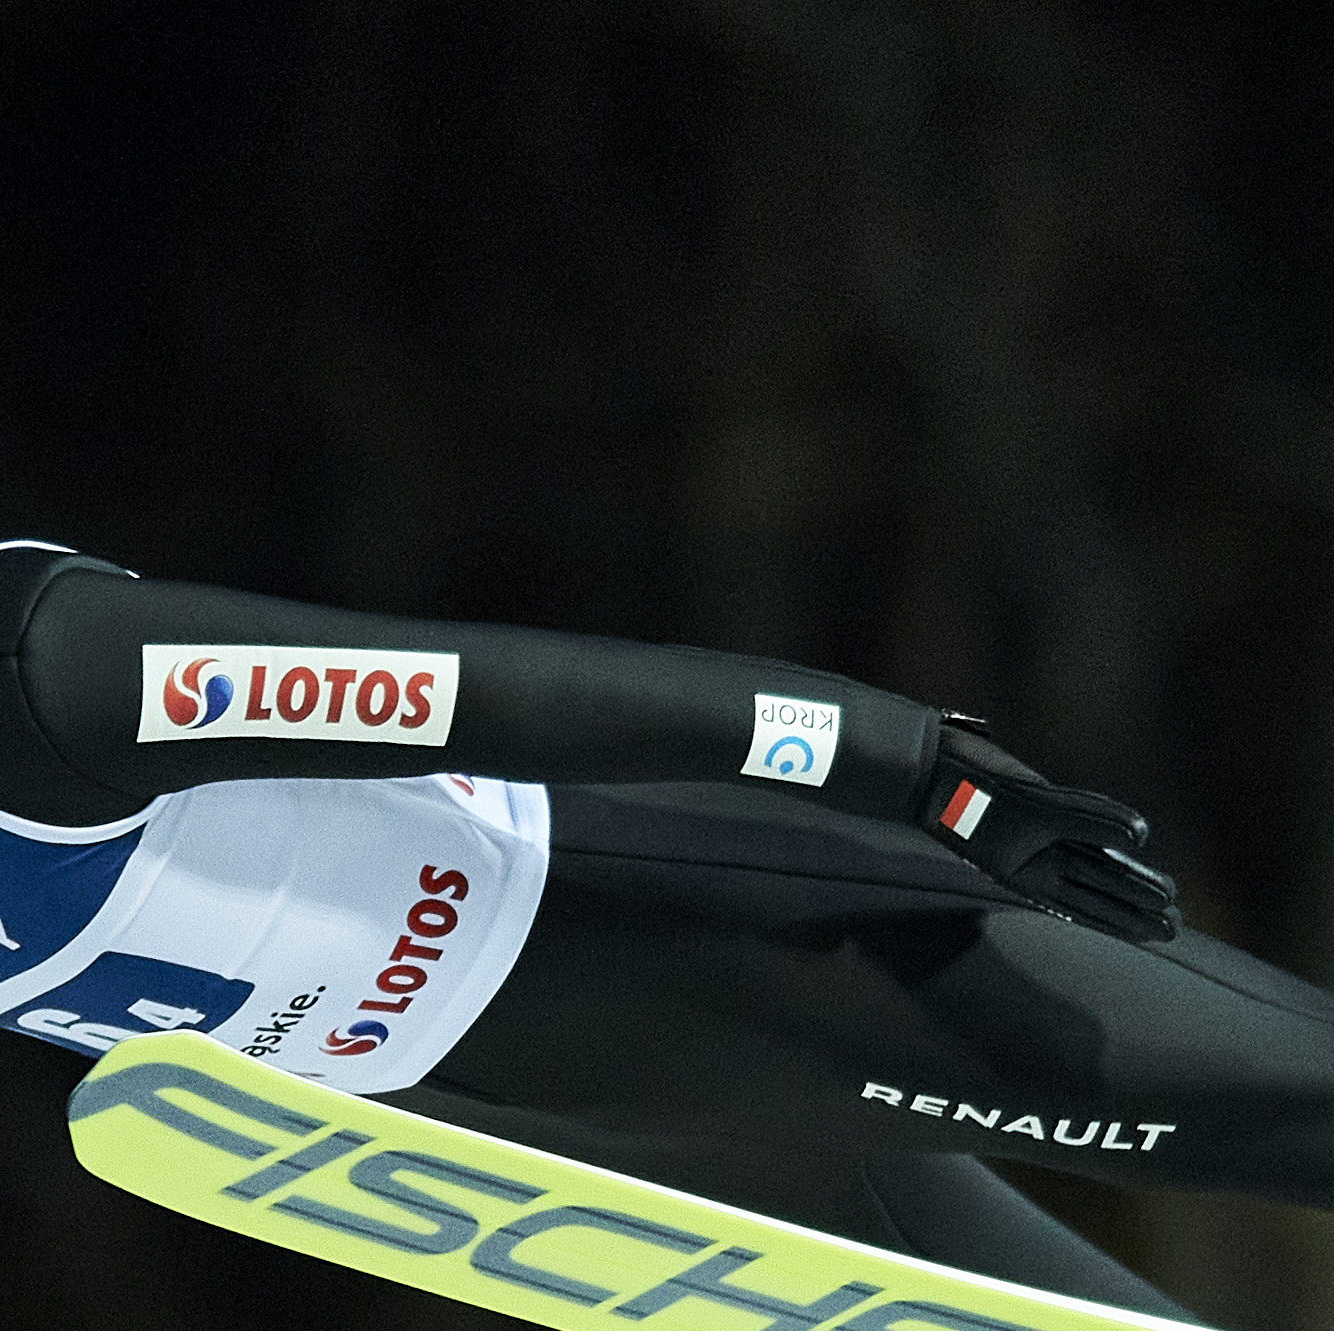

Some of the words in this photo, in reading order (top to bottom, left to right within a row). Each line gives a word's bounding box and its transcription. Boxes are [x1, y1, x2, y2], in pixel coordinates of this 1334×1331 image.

[244, 665, 435, 729] LOTOS
[356, 864, 469, 1014] LOTOS
[861, 1082, 1177, 1151] RENAULT
